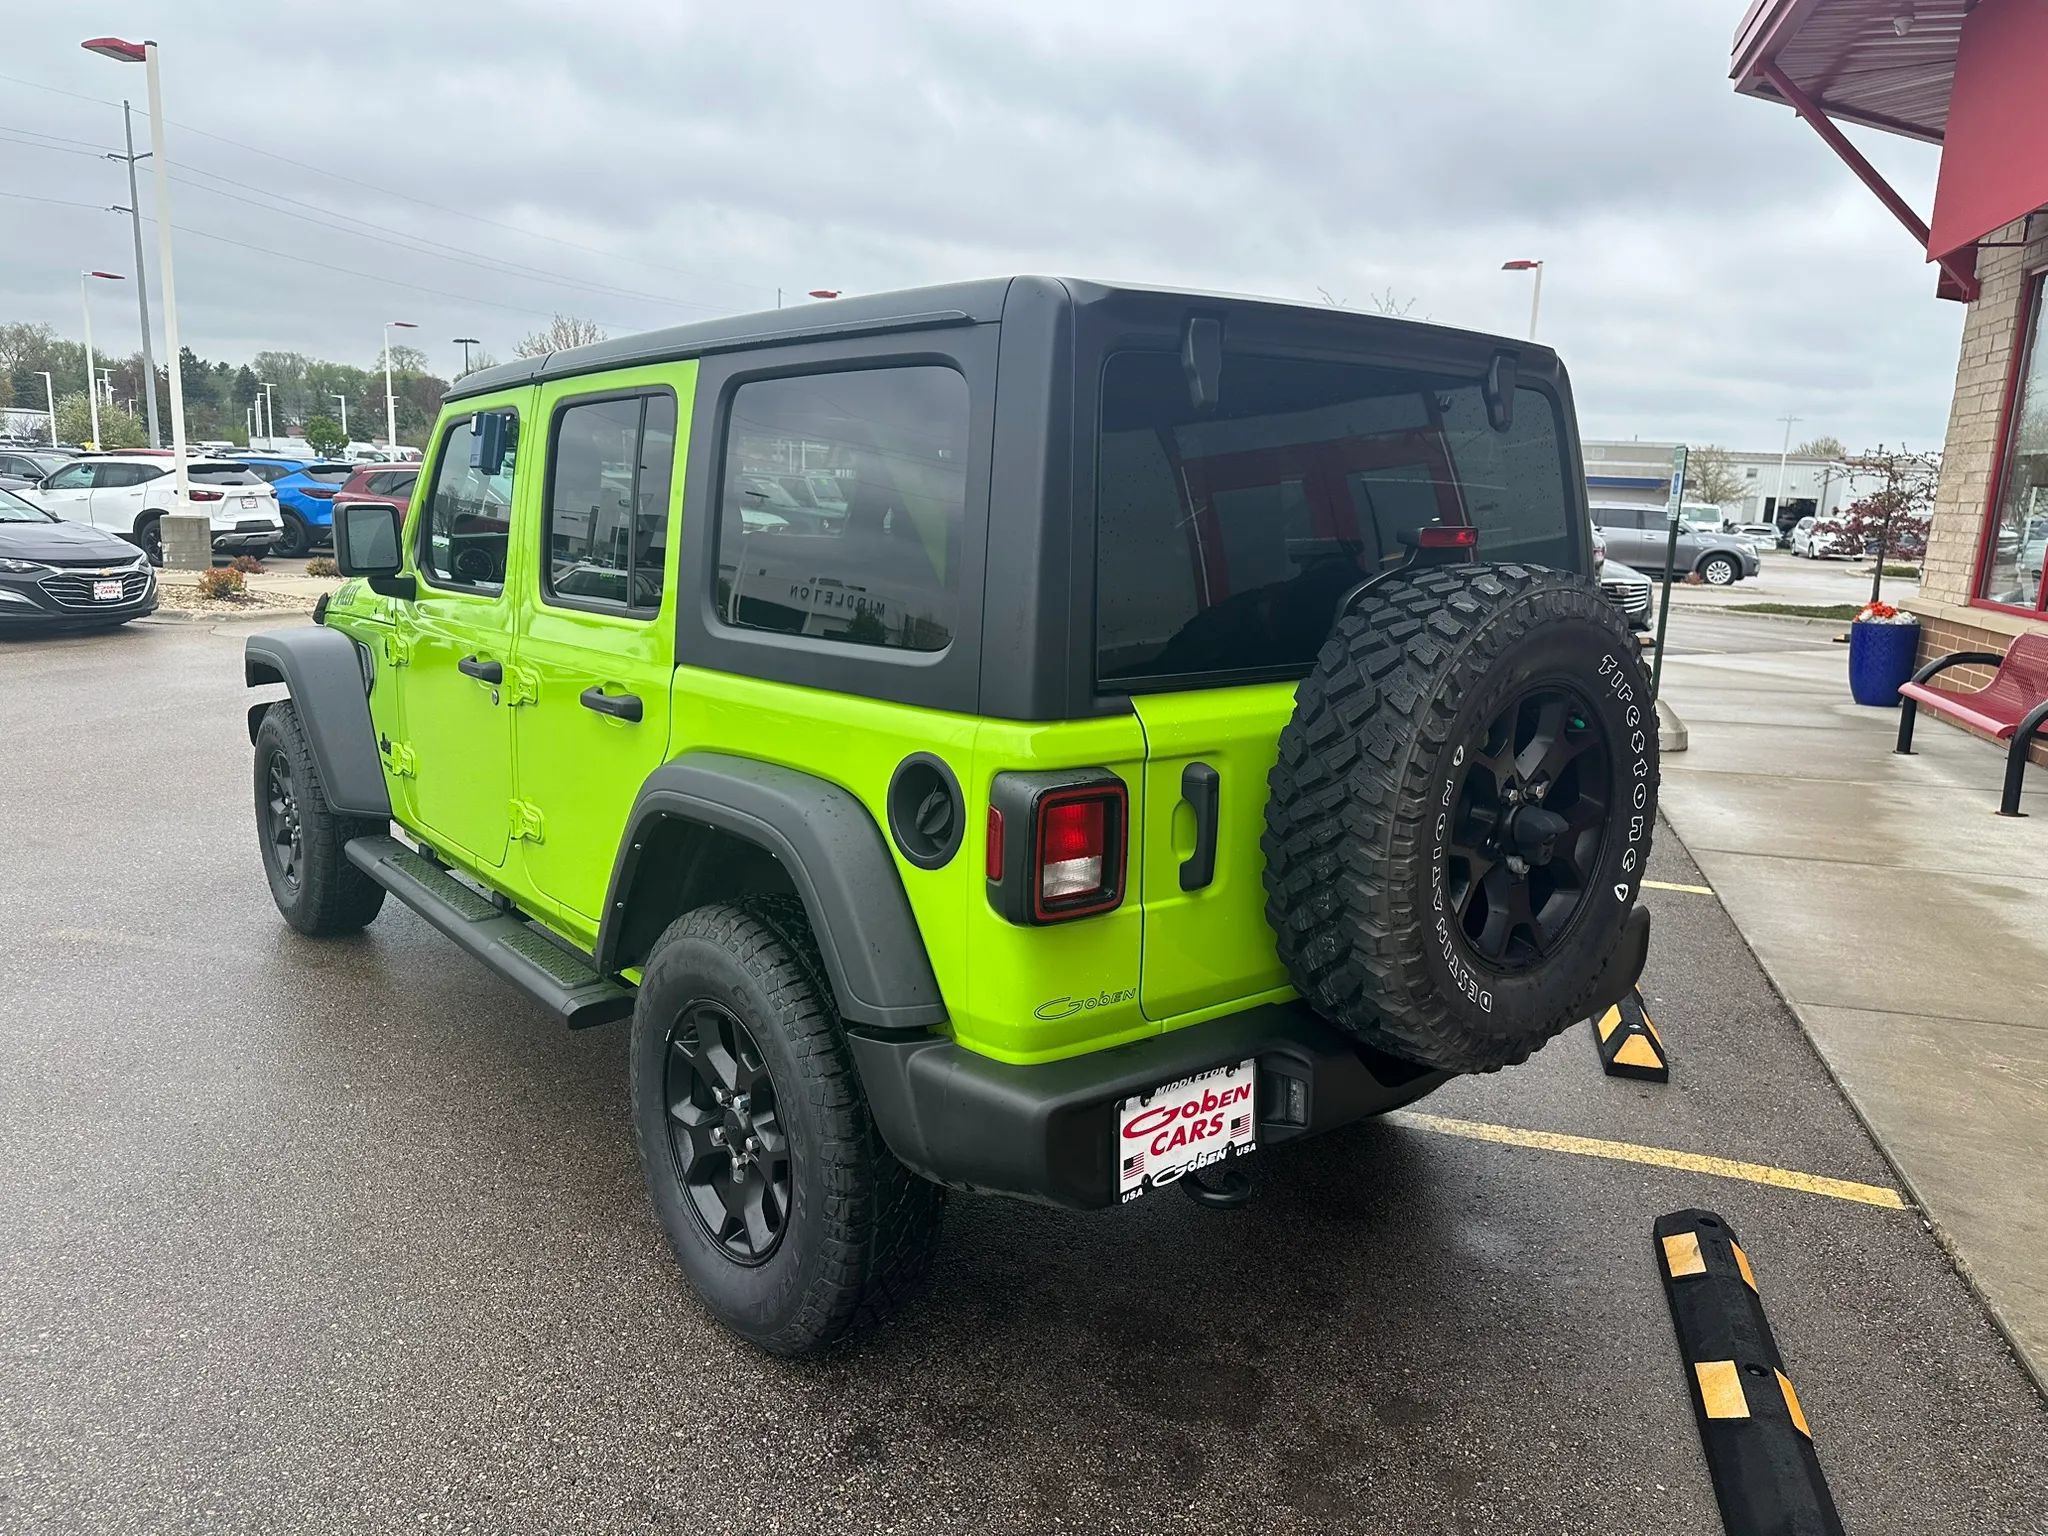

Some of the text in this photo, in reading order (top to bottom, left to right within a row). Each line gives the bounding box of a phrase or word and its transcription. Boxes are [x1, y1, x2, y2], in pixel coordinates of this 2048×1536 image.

[1598, 654, 1649, 872] Firestone
[1432, 779, 1493, 1014] DESTINATION
[1154, 1065, 1229, 1097] MIDDLETON
[1150, 1112, 1226, 1157] CARS
[1121, 1186, 1143, 1204] USA
[1235, 1142, 1257, 1157] USA
